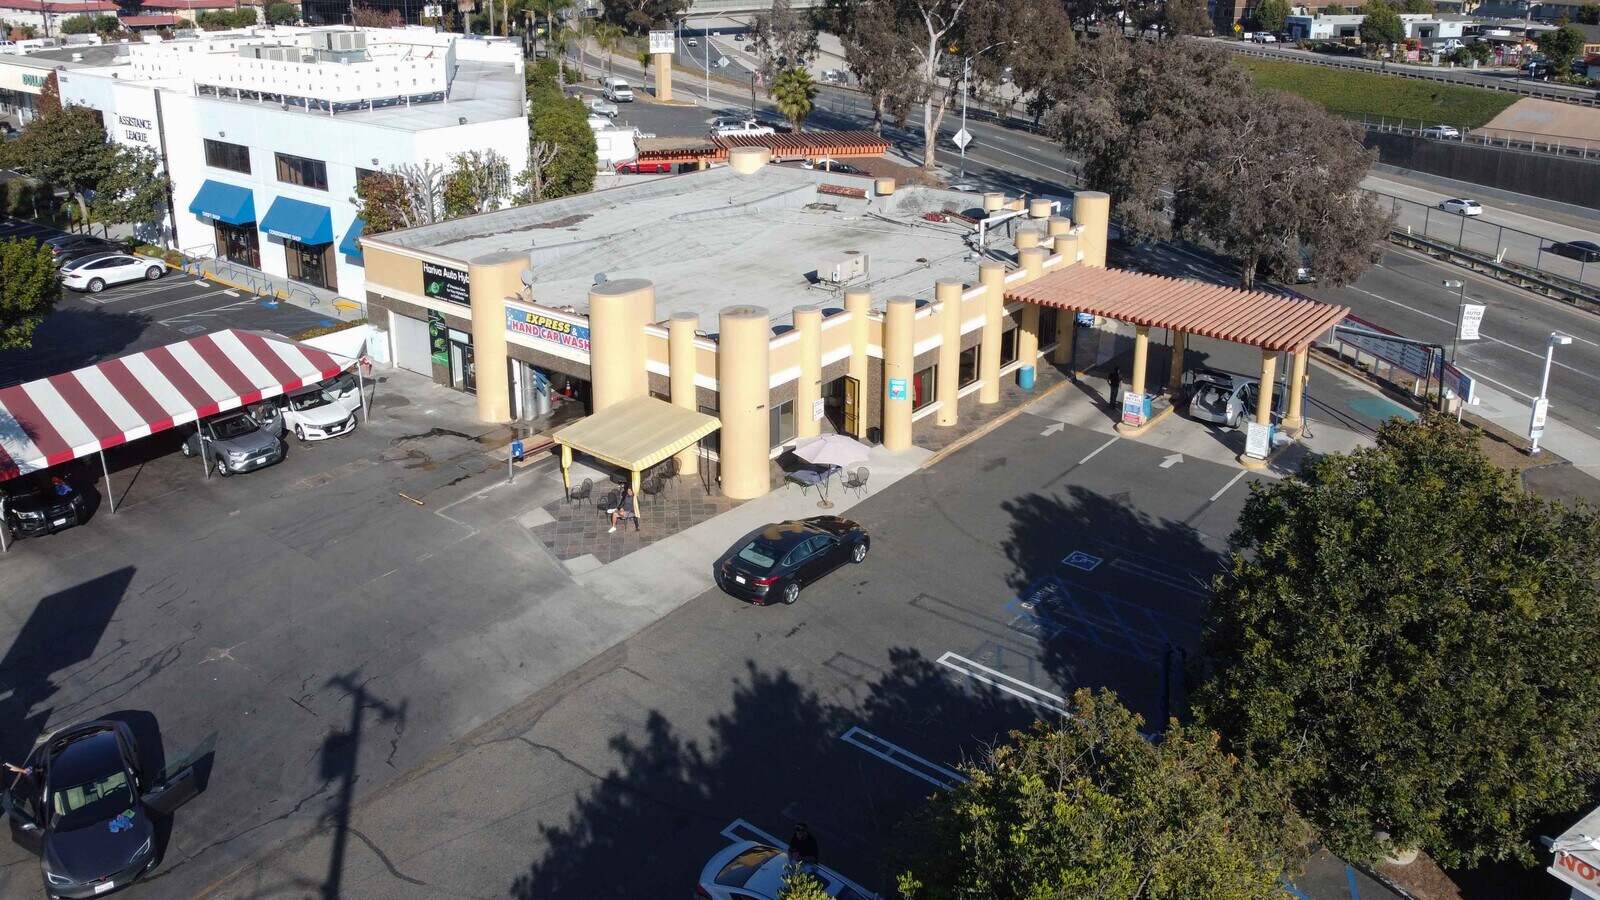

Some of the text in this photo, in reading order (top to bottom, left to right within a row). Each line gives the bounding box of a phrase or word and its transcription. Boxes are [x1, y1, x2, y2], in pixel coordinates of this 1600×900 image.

[118, 115, 152, 130] ASSISTANCE
[125, 129, 148, 143] LEAGUE
[423, 262, 443, 277] Hariva
[443, 267, 457, 280] Auto
[525, 313, 578, 336] EXPRESS &
[512, 320, 590, 351] HAND CAR WASH
